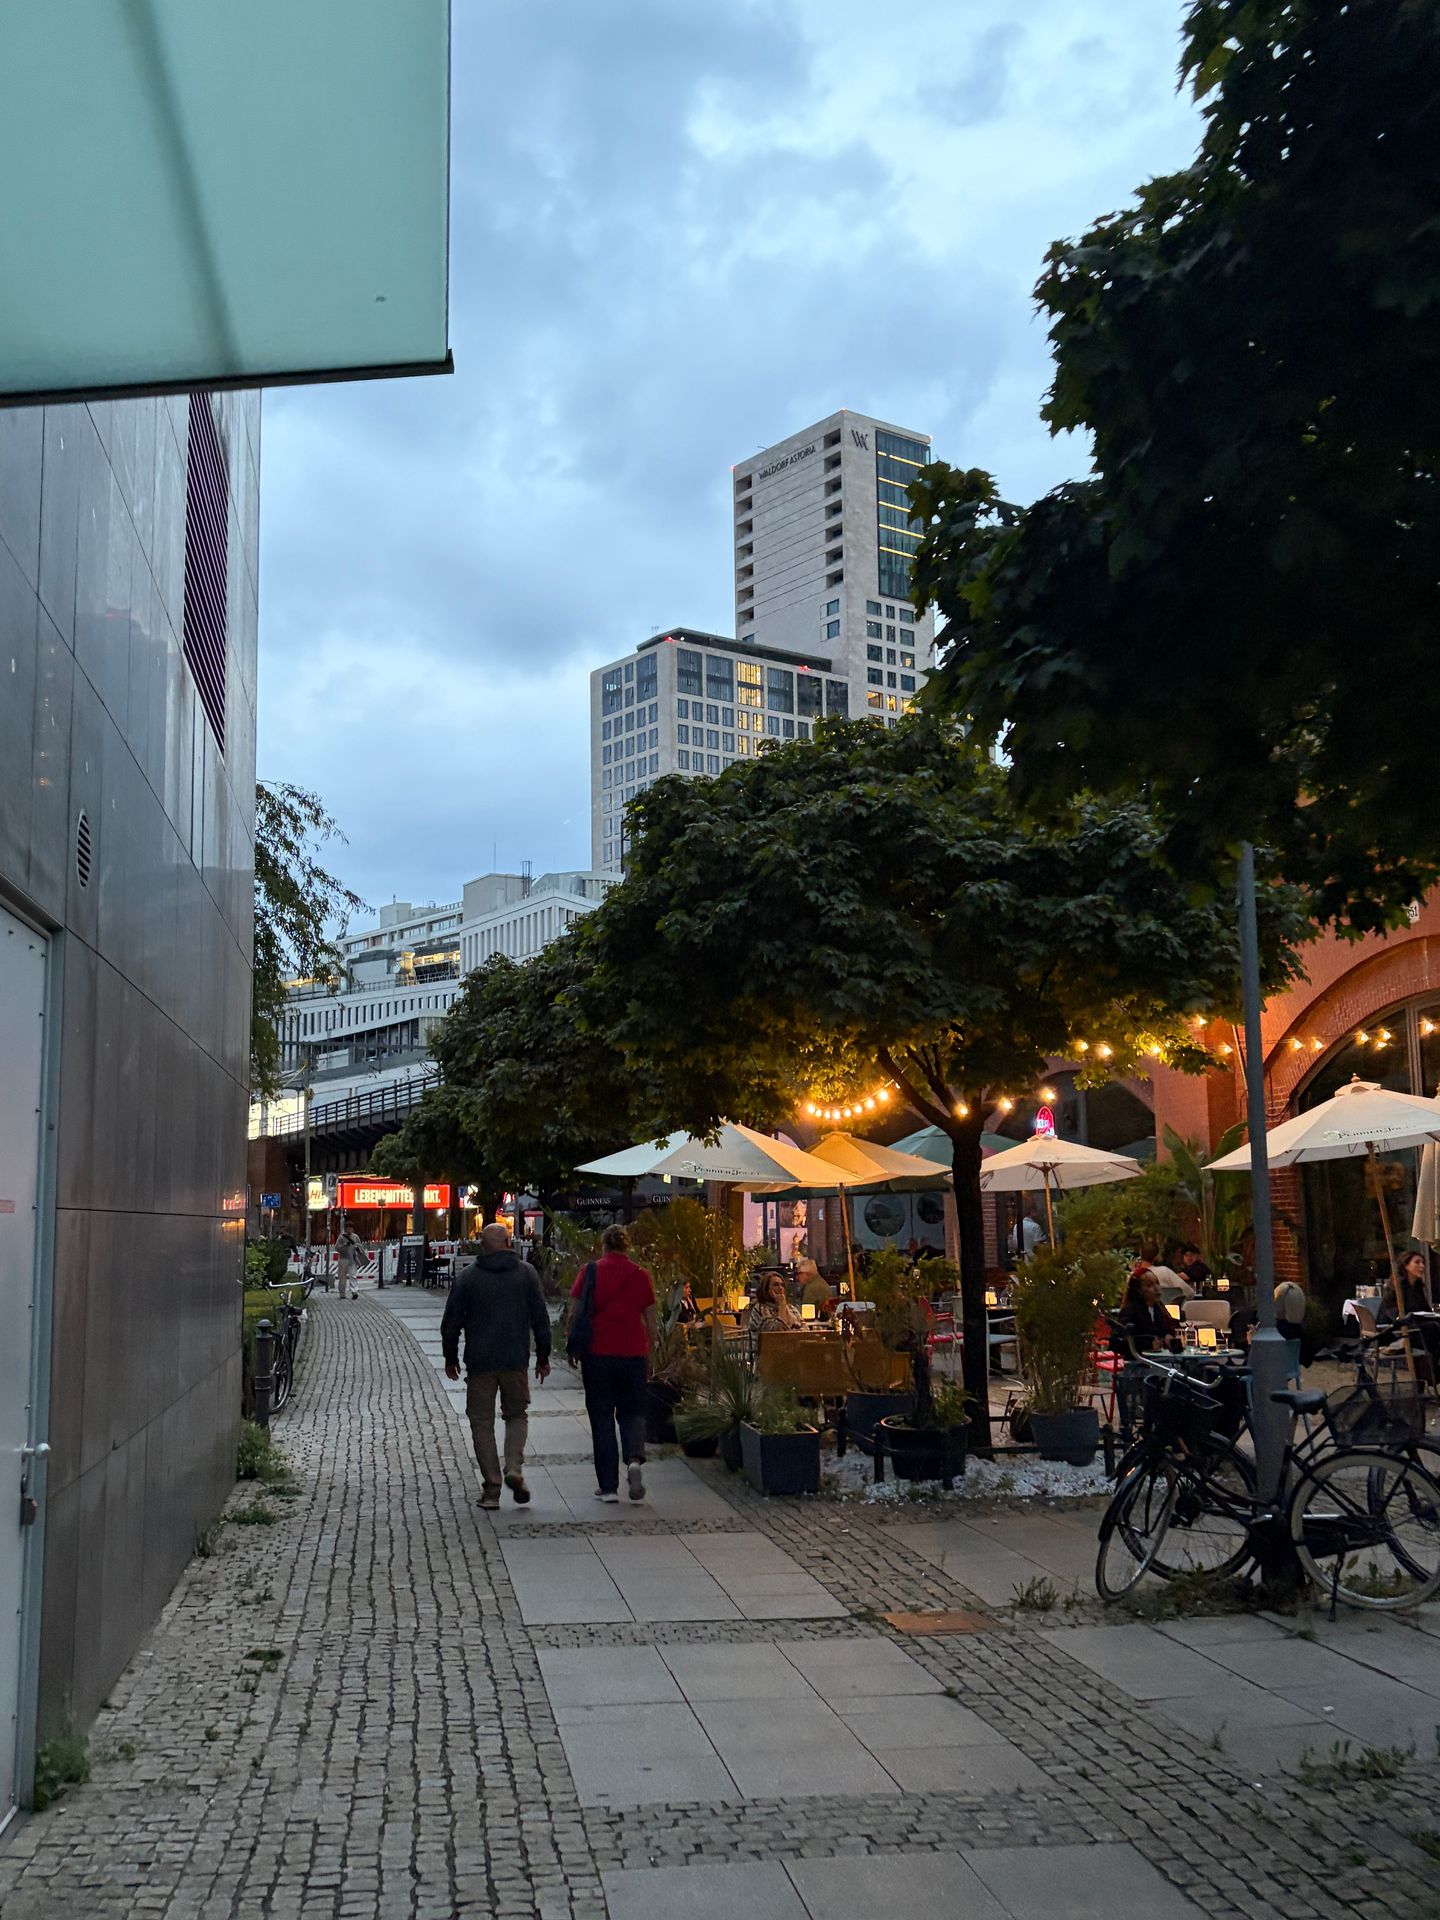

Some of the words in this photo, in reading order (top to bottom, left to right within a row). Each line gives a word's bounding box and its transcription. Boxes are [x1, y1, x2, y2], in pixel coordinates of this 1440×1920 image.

[759, 458, 789, 480] WALDORF
[789, 444, 817, 466] ASTORIA
[354, 1188, 441, 1204] LEBENSMITTELRKT.
[576, 1197, 611, 1206] GUINNESS
[652, 1194, 671, 1204] GUIN
